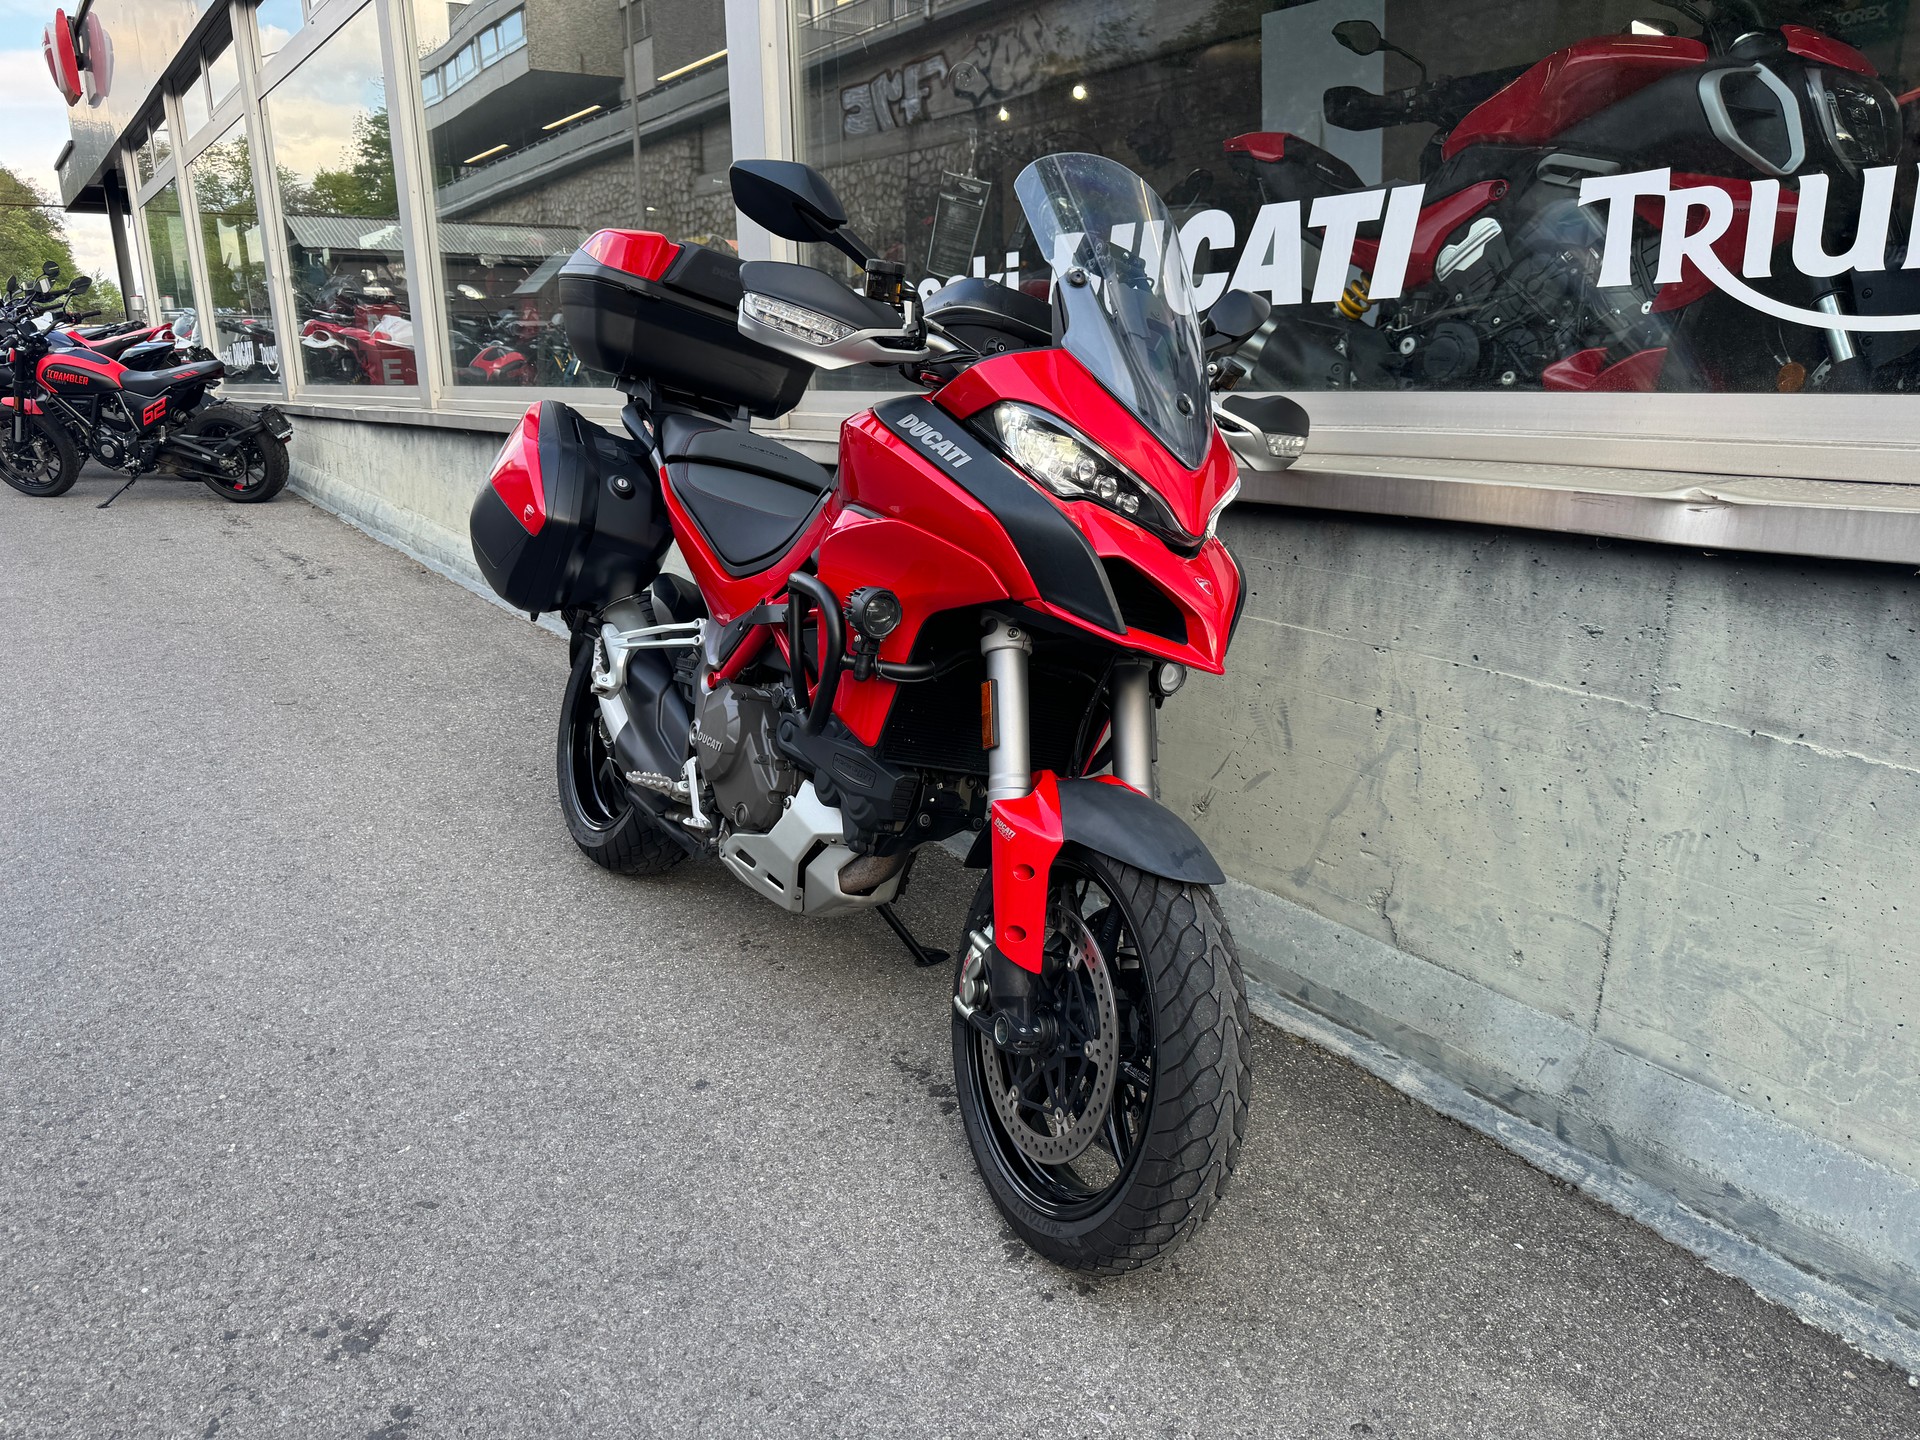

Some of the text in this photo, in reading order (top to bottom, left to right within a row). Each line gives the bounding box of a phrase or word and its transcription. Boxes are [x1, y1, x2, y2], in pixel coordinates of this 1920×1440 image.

[1577, 166, 1920, 331] TRIU
[46, 369, 89, 386] SCRAMBLER
[143, 396, 168, 427] 62
[896, 413, 973, 469] DUCATI
[697, 731, 723, 752] DUCATI
[994, 817, 1017, 838] DUCATI
